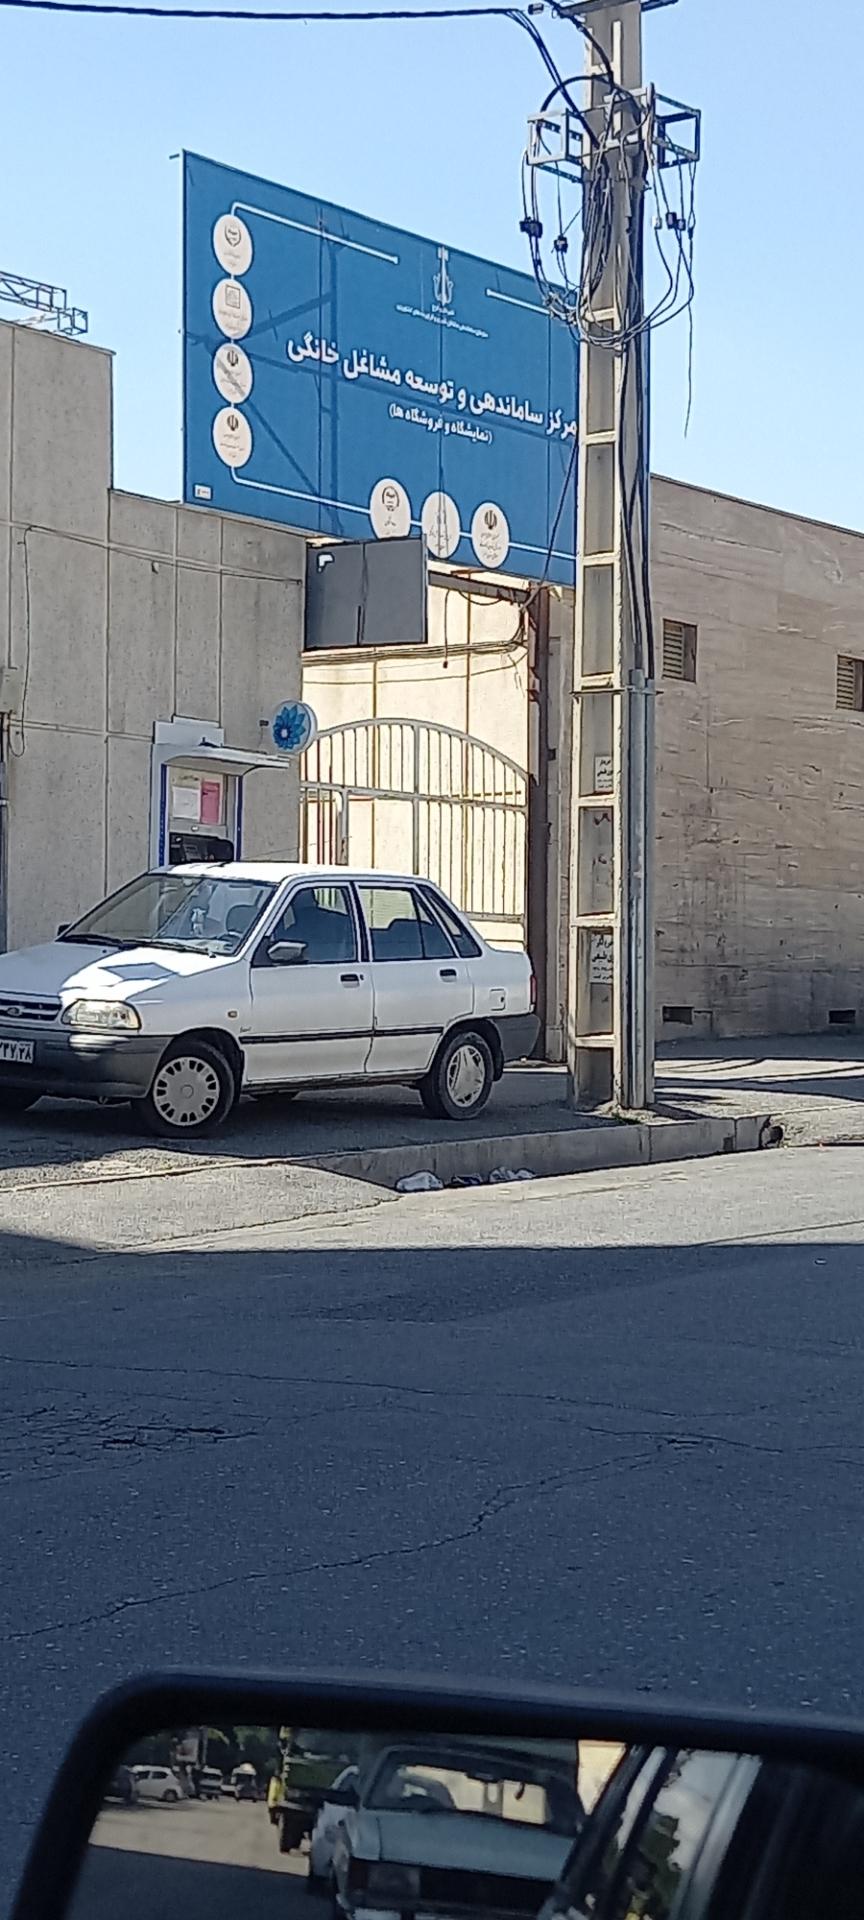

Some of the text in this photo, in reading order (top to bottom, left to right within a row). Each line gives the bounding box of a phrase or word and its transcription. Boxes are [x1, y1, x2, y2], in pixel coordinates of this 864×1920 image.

[287, 330, 577, 440] مرکز ساماندهی و توسعه مشاغل خانگی
[405, 407, 444, 432] فروشگاه
[444, 421, 451, 436] و
